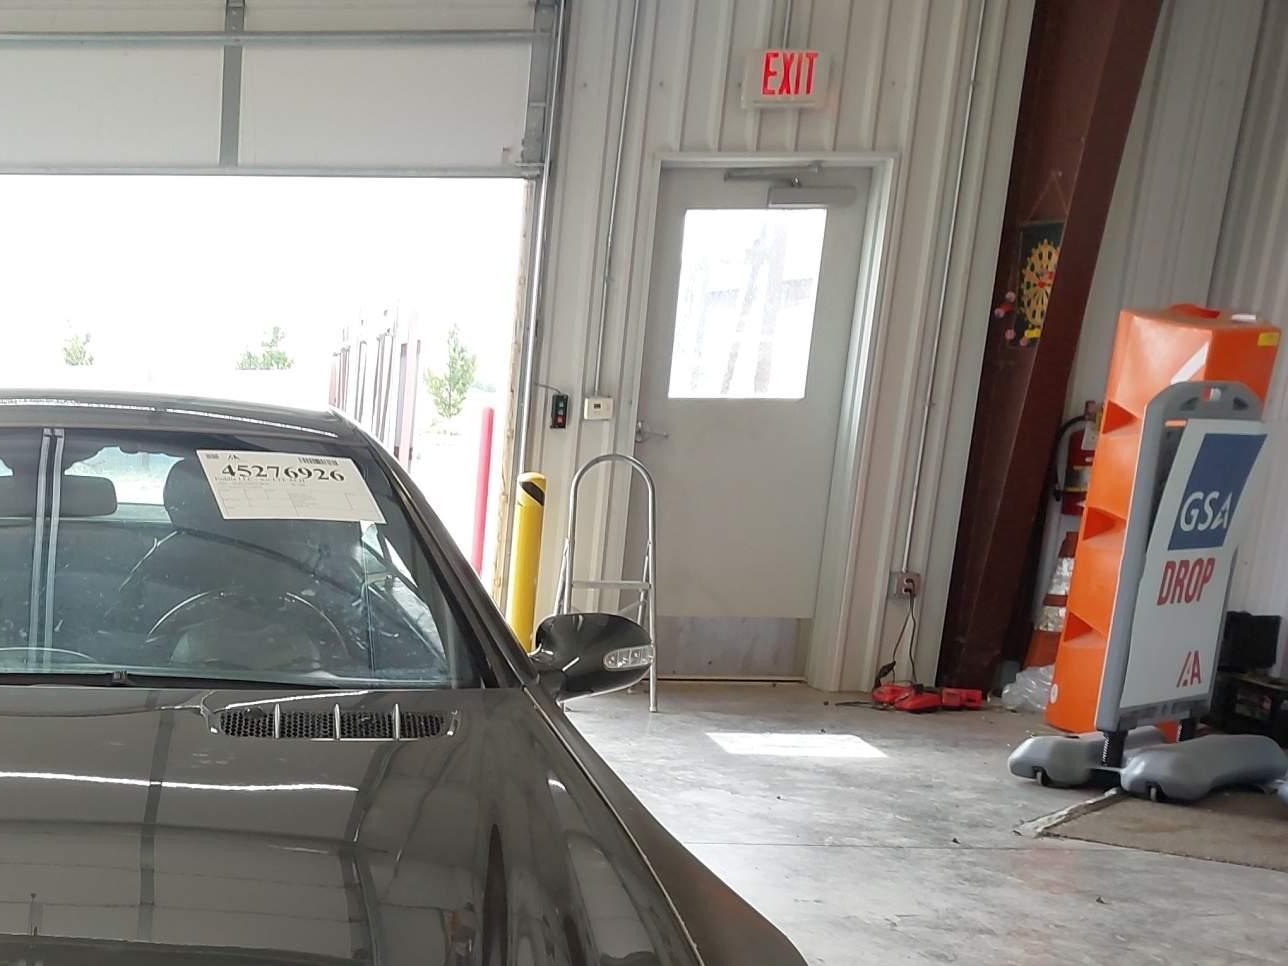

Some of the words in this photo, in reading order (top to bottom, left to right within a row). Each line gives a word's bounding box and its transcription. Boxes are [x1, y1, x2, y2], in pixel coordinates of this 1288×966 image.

[761, 50, 819, 97] EXIT
[222, 463, 345, 483] 45276926
[1179, 490, 1233, 532] GSA
[1156, 557, 1216, 606] DROP
